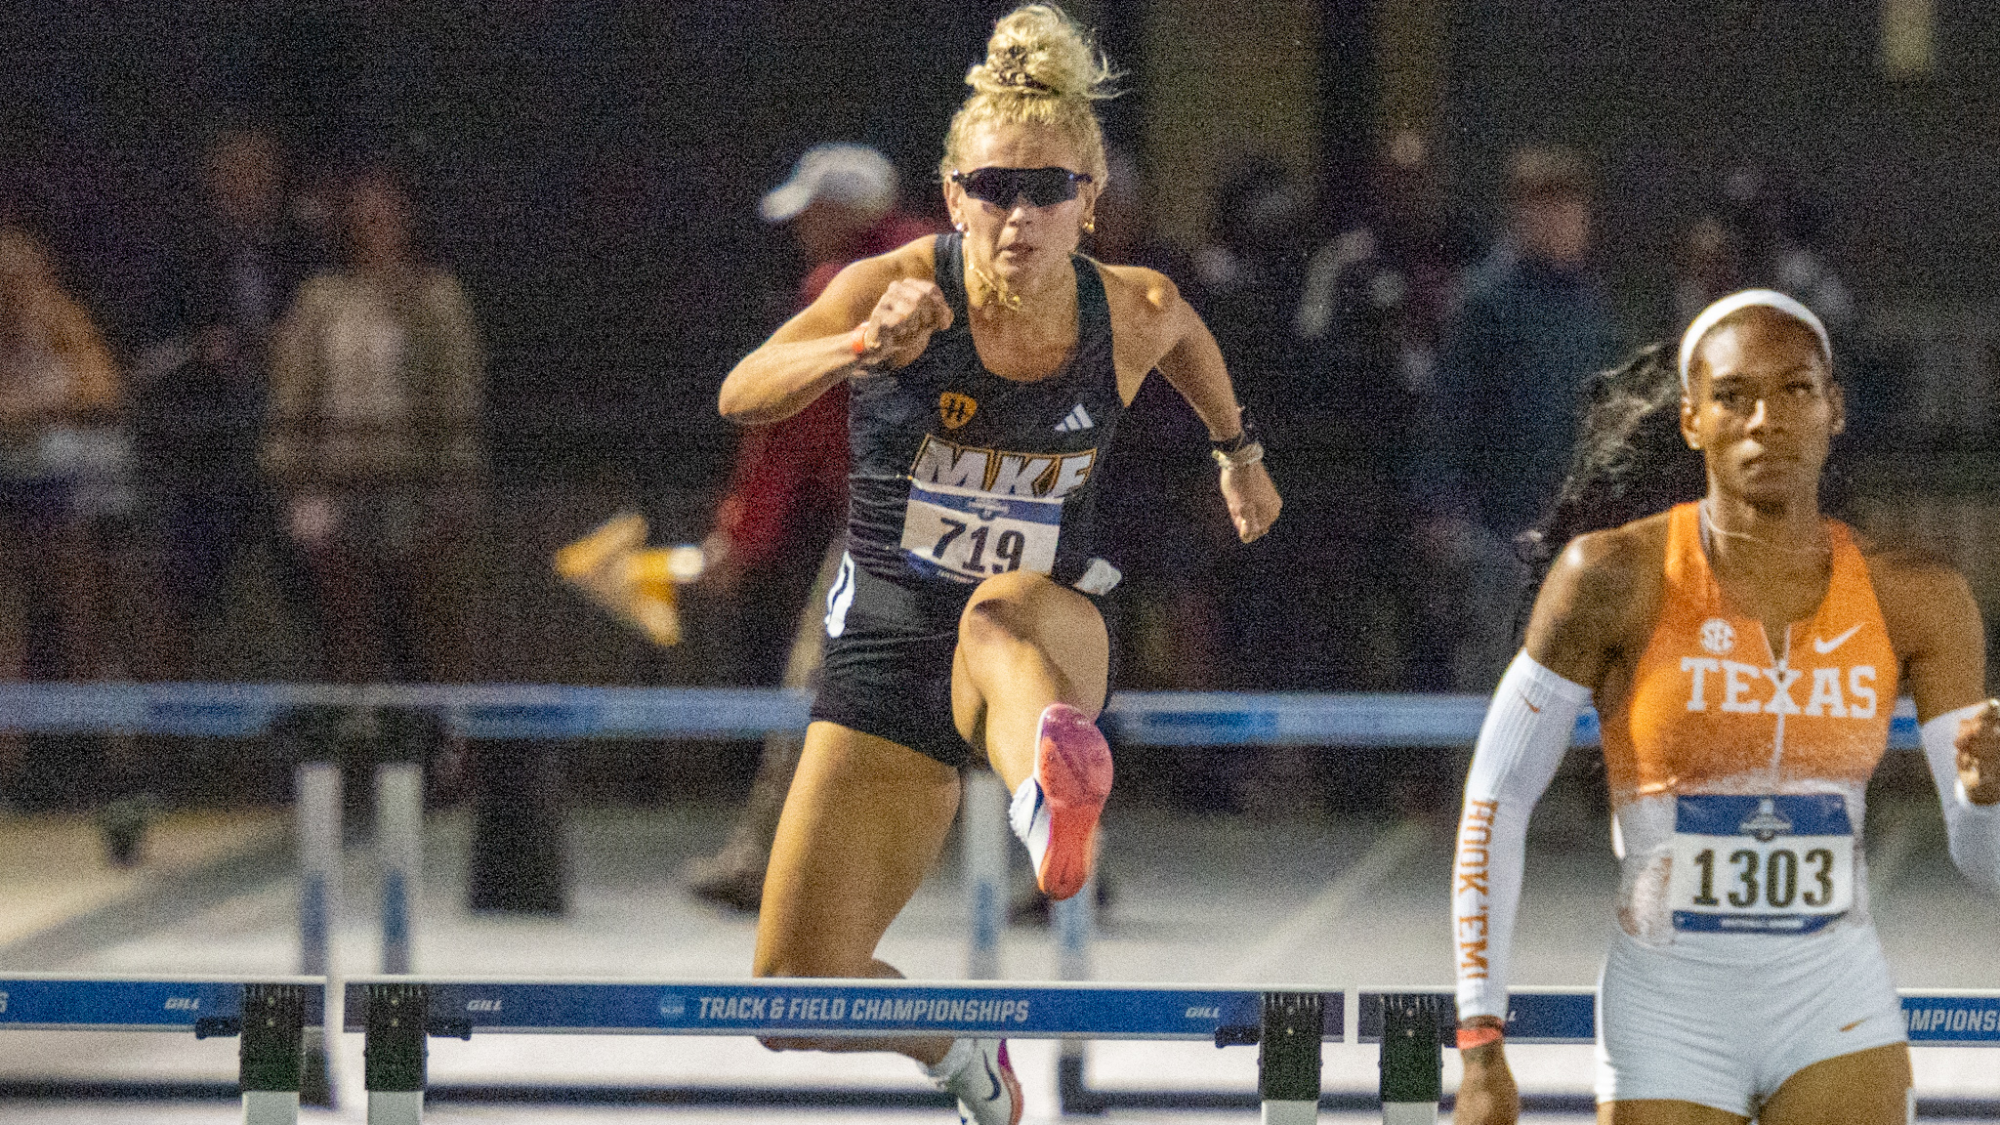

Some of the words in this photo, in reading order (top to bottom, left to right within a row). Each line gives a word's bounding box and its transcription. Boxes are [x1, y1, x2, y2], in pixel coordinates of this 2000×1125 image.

[932, 517, 1026, 575] 719
[1681, 657, 1876, 719] TEXAS
[1458, 798, 1499, 897] HOOK
[1693, 848, 1834, 908] 1303
[700, 997, 765, 1020] TRACK
[769, 998, 785, 1020] &
[788, 998, 847, 1021] FIELD
[851, 999, 1030, 1023] CHAMPIONSHIPS
